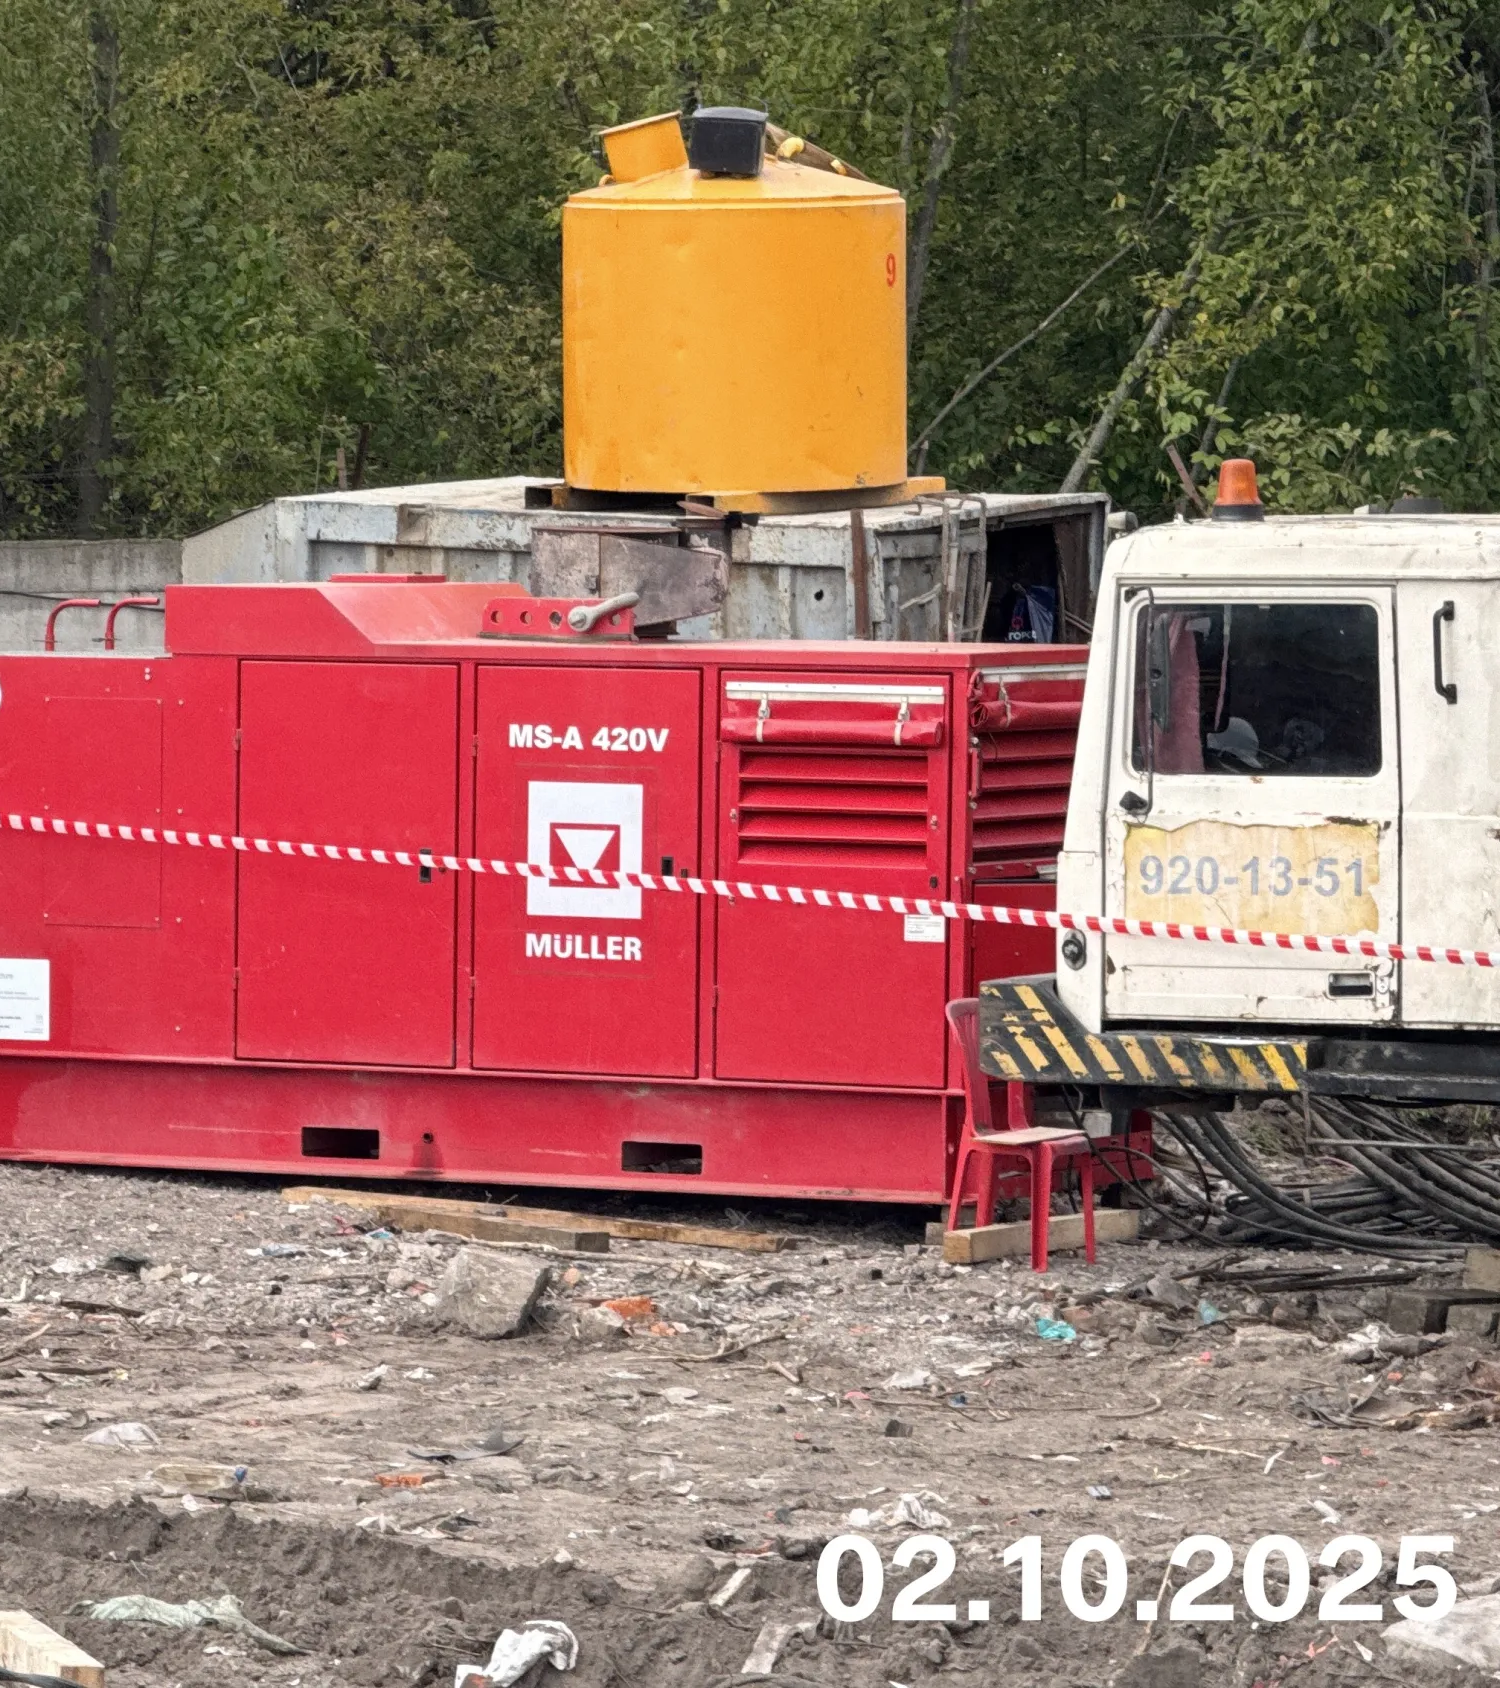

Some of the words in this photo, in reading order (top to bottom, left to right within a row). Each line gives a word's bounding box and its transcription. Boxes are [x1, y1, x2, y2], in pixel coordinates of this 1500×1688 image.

[886, 253, 896, 288] 9
[508, 724, 584, 750] MS-A
[592, 727, 669, 752] 420V
[1139, 855, 1363, 897] 920-13-51
[525, 932, 642, 961] MÜLLER
